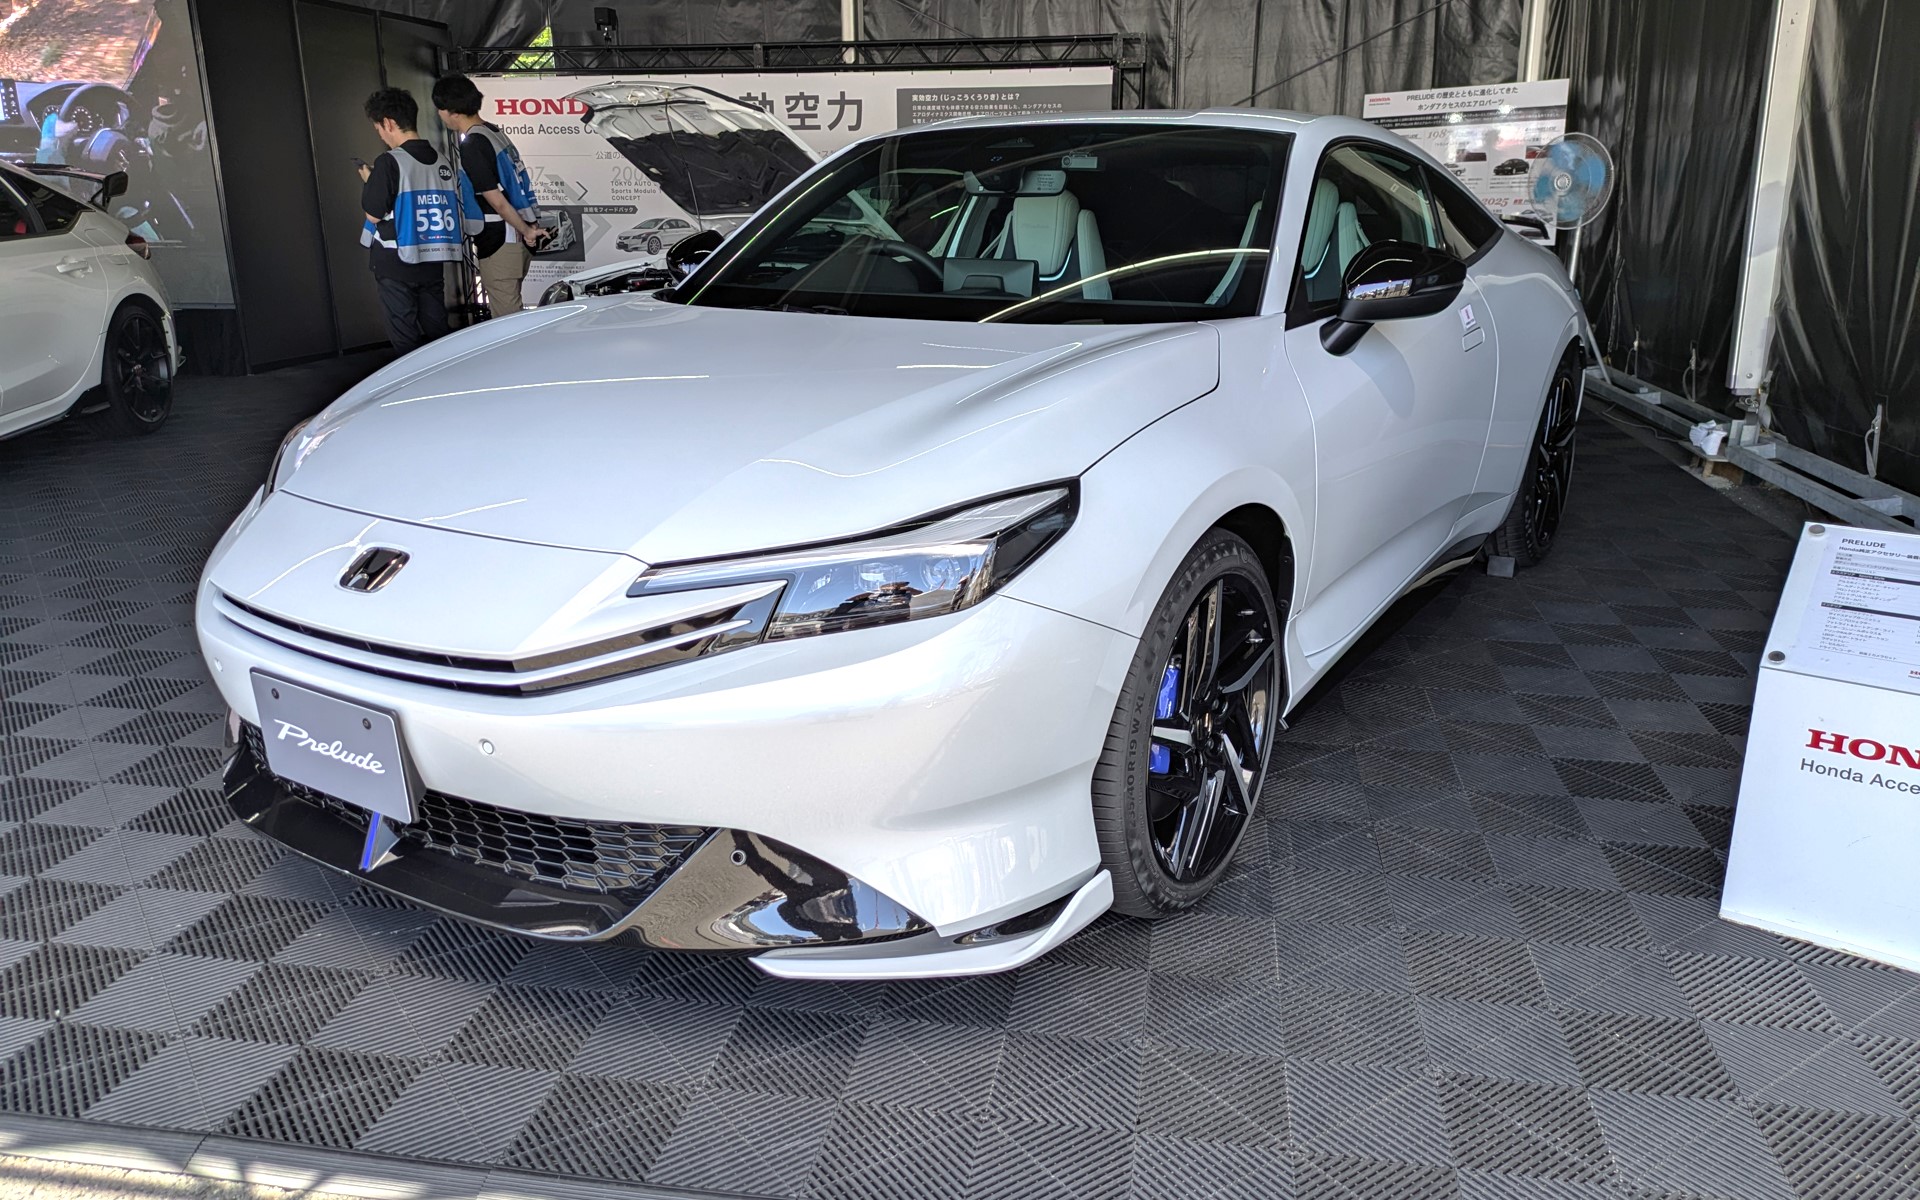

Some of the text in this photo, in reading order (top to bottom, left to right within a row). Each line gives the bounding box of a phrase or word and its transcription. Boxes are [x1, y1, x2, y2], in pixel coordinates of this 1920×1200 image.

[1406, 93, 1435, 101] PRELUDE
[1417, 99, 1505, 111] ホンダアクセスのエアロパーツ
[495, 98, 588, 116] HOND
[538, 124, 580, 135] Access
[439, 168, 452, 177] 536
[612, 166, 648, 182] 200
[417, 194, 449, 206] MEDIA
[415, 207, 456, 233] 536
[1841, 538, 1887, 549] PRELUDE
[1134, 692, 1145, 714] XL
[1130, 719, 1141, 735] W
[273, 718, 386, 775] Prelude
[1805, 728, 1920, 770] HON
[1800, 757, 1920, 795] Honda Acce
